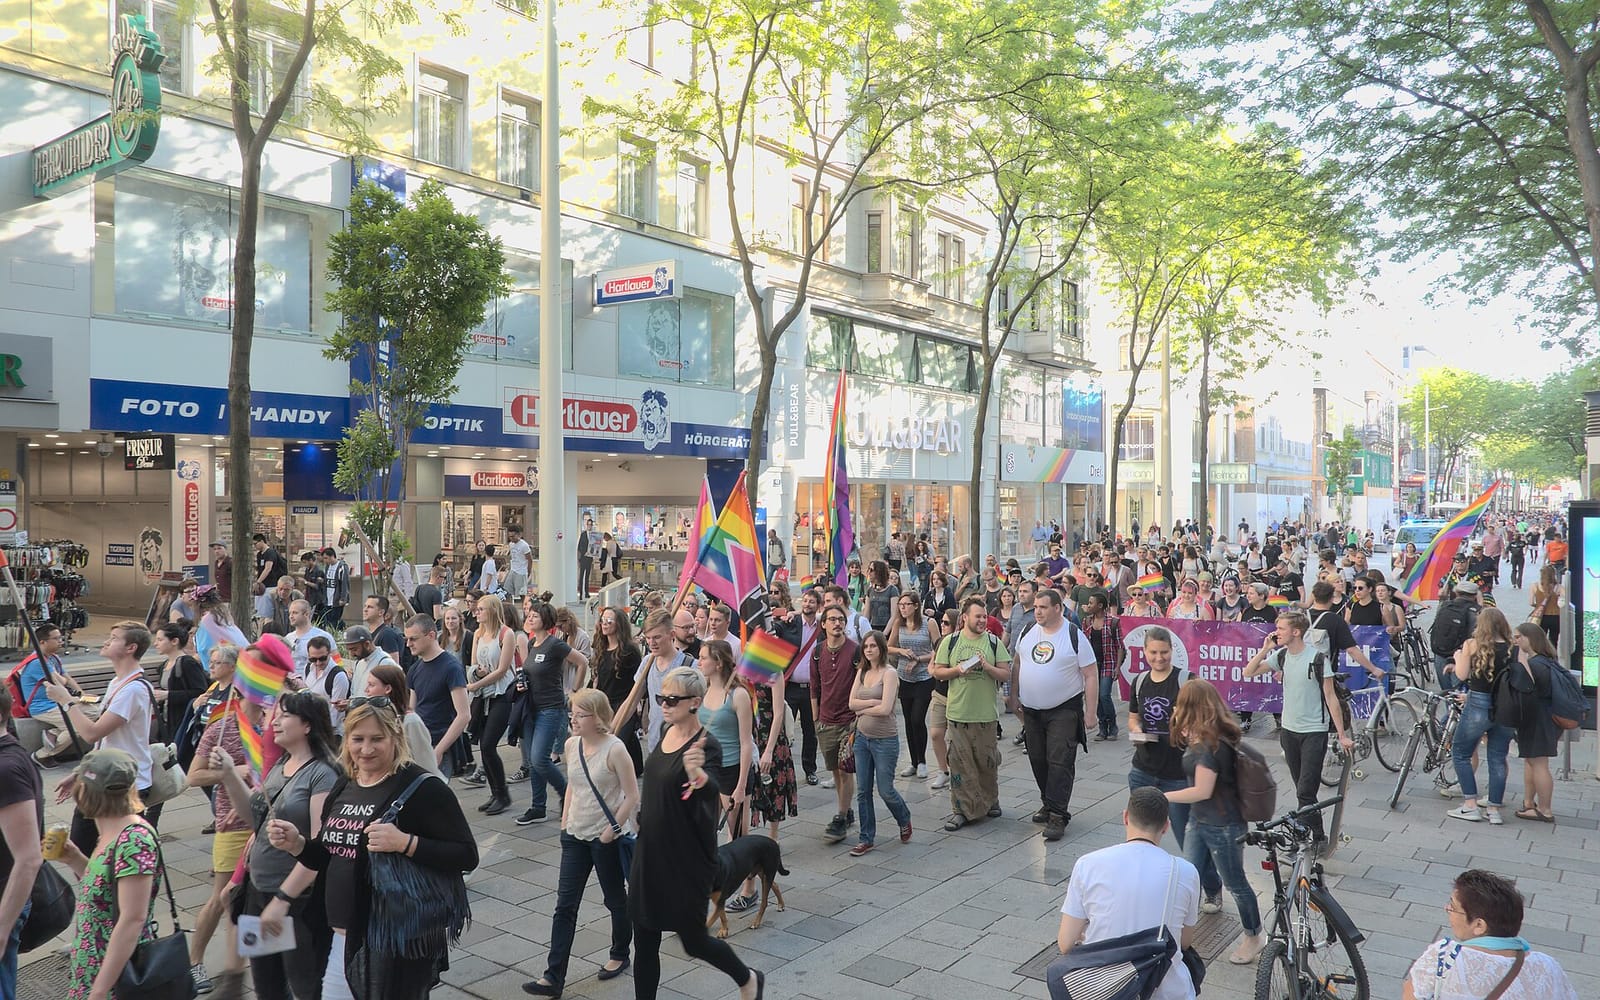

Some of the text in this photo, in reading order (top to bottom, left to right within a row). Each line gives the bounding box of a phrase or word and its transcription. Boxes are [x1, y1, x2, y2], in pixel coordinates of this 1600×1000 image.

[608, 278, 652, 295] Hartlauer
[121, 398, 331, 425] FOTO HANDY
[789, 383, 799, 447] PULL&BEAR
[424, 416, 484, 432] OPTIK
[126, 438, 163, 457] FRISEUR
[477, 473, 522, 487] Hartlauer
[186, 487, 198, 556] Hartlauer
[1200, 643, 1242, 661] SOME
[1200, 664, 1228, 682] GET
[340, 804, 375, 816] TRANS
[322, 831, 343, 843] ARE
